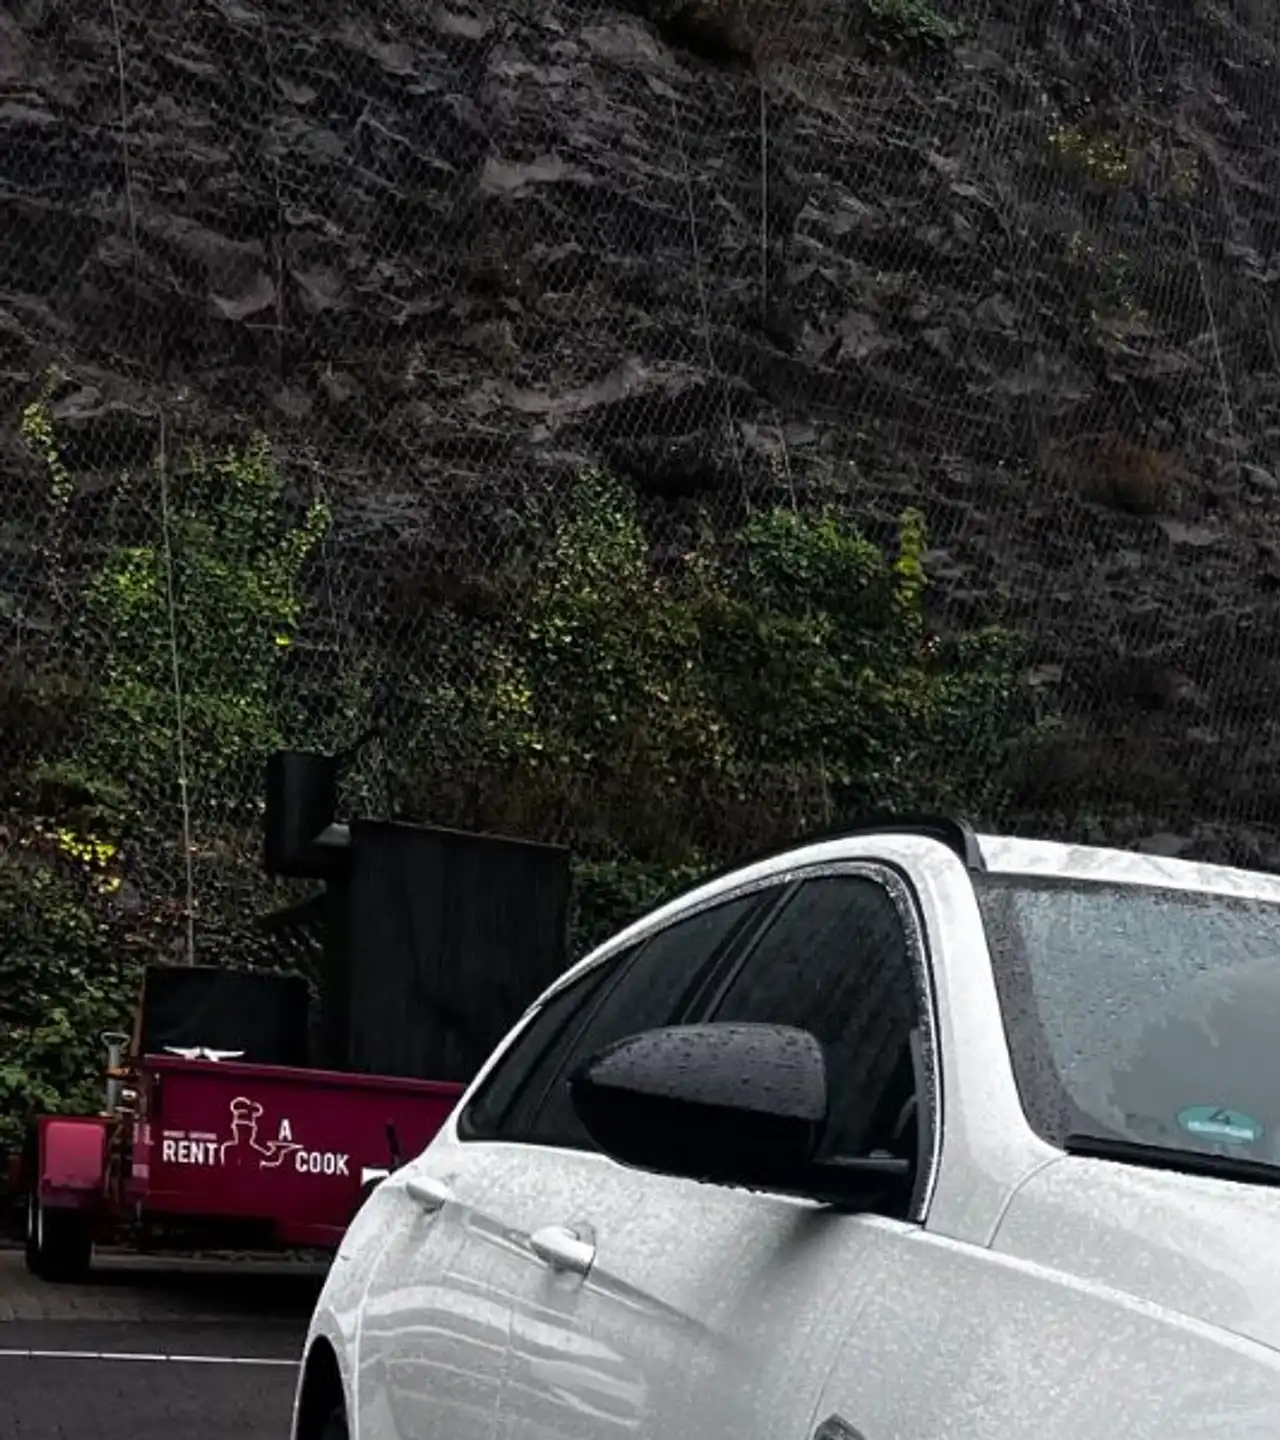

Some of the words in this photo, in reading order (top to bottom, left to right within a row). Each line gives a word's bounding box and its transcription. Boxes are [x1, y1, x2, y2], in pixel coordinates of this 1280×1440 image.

[162, 1140, 218, 1165] RENT
[278, 1118, 293, 1141] A
[295, 1151, 350, 1176] COOK
